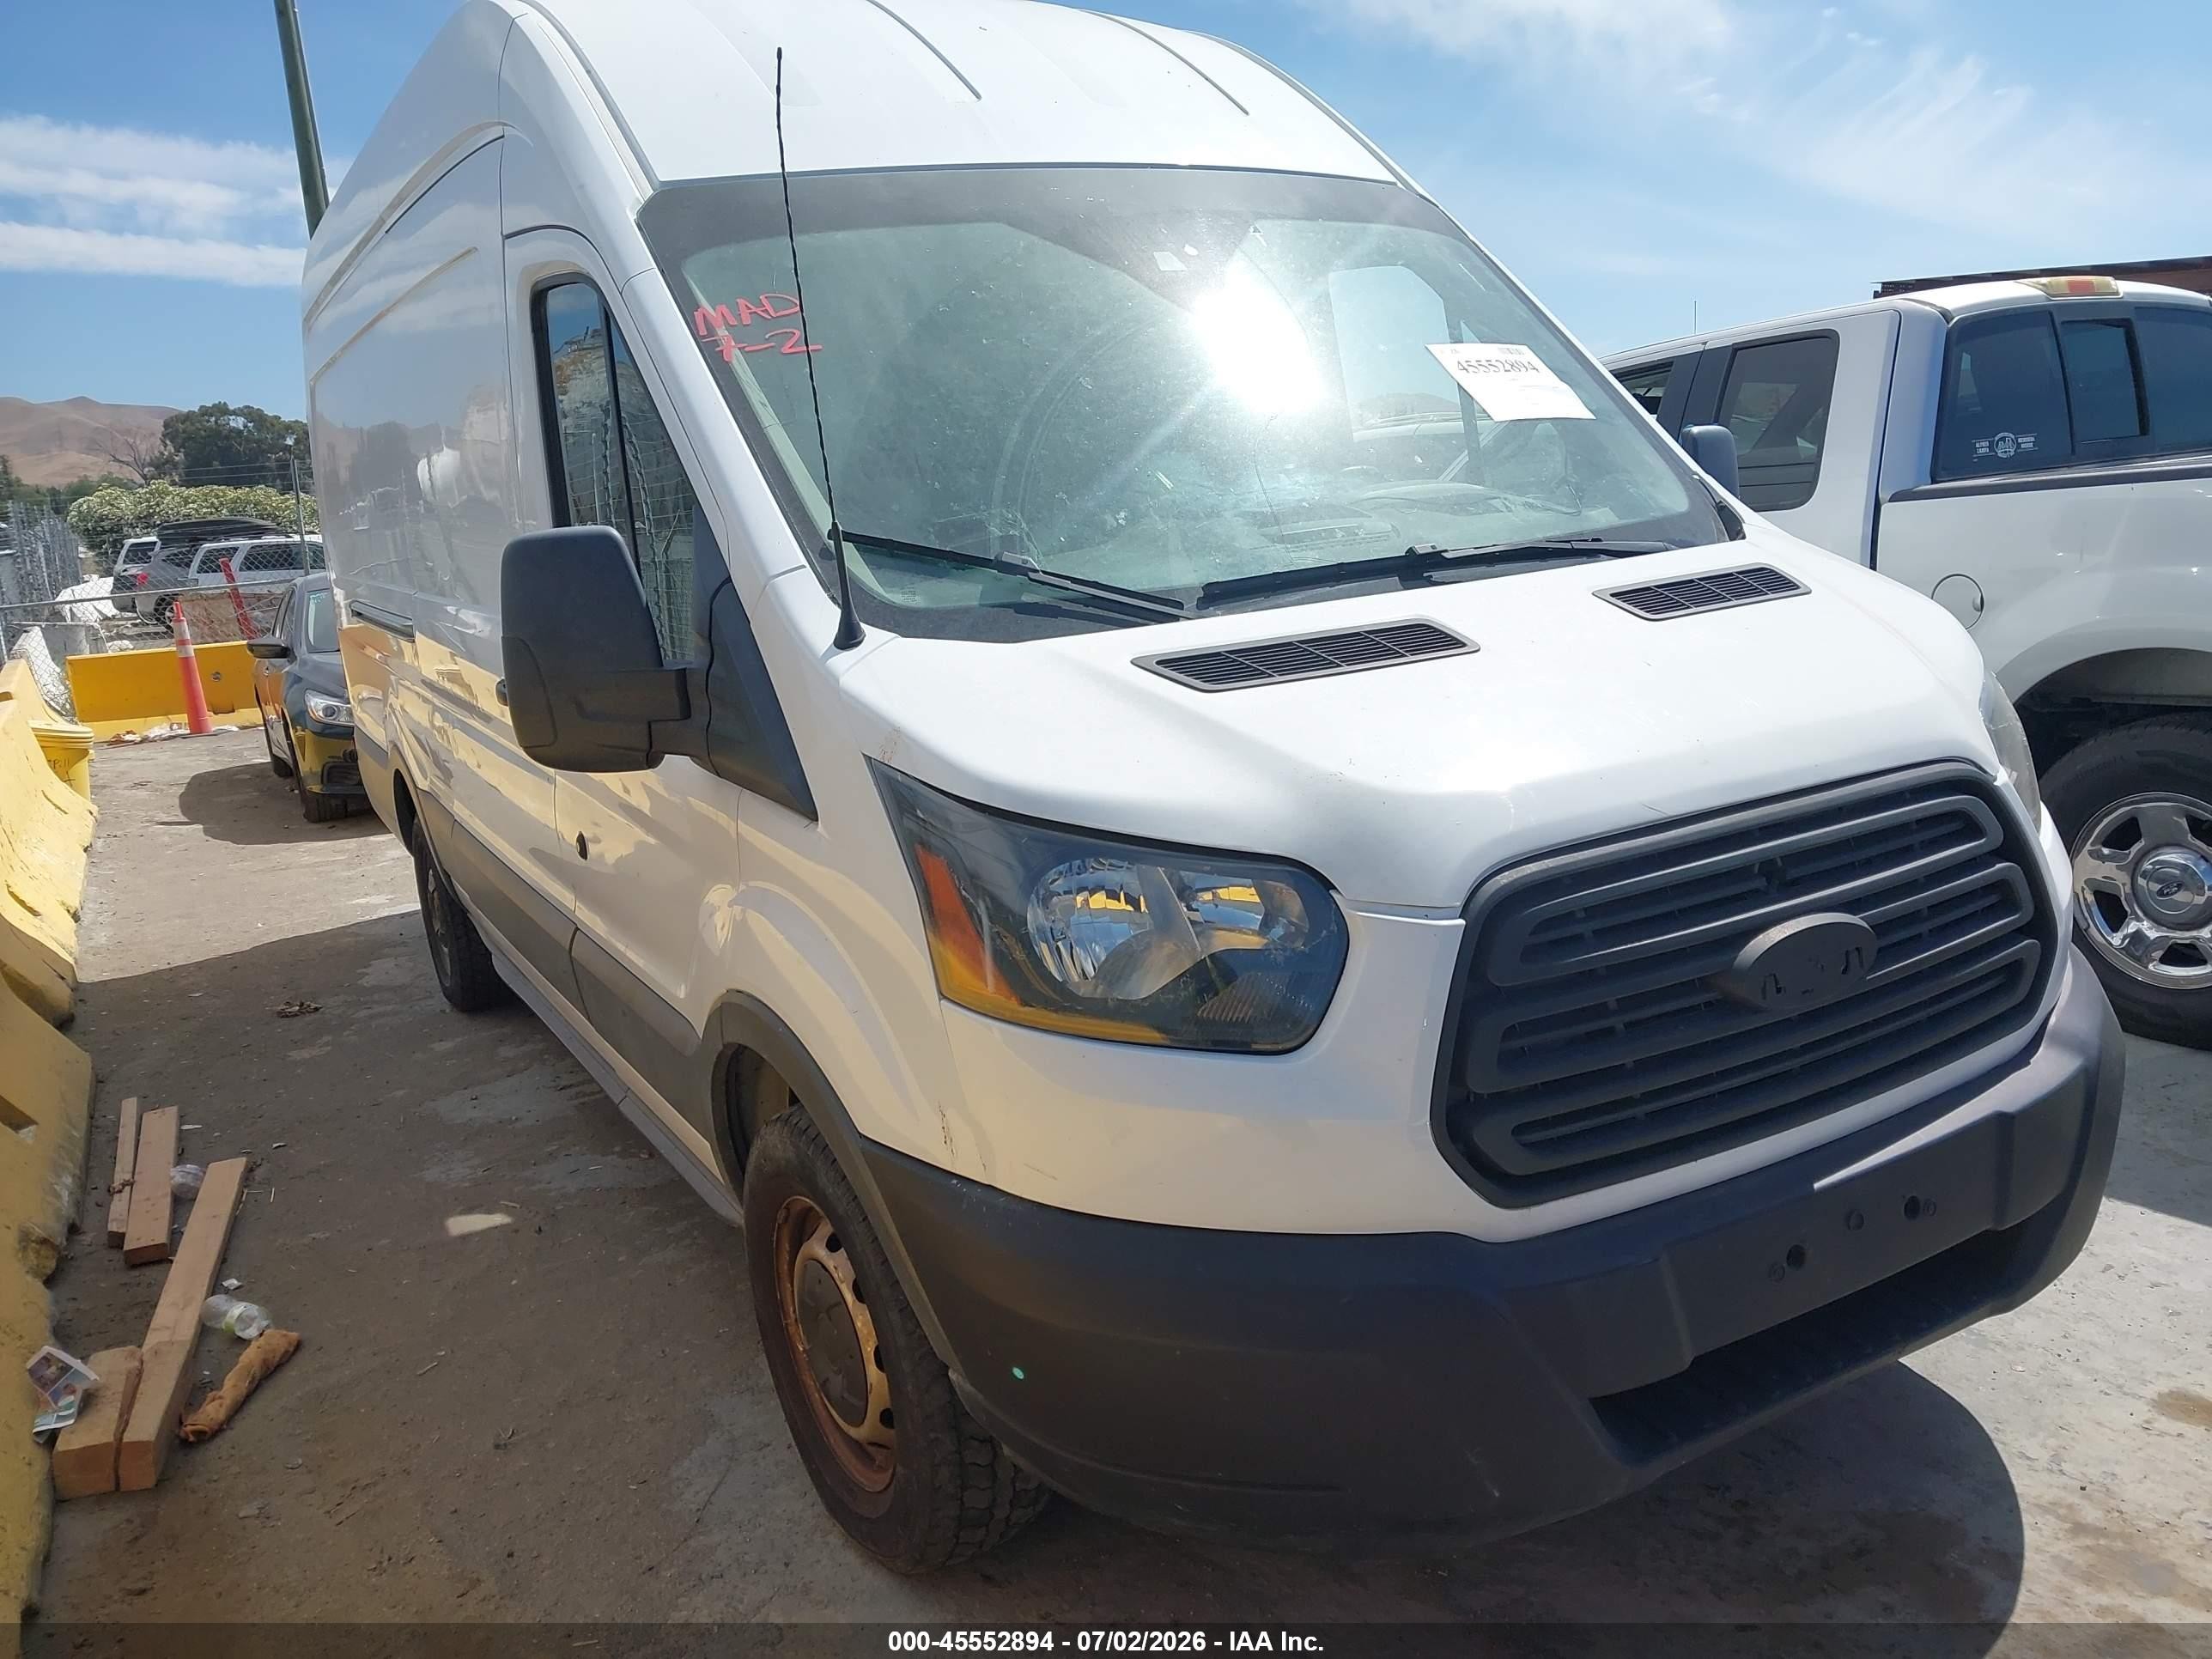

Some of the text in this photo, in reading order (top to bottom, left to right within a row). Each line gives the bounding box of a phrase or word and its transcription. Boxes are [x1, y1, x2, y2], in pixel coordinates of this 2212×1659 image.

[693, 292, 800, 337] MAD
[700, 328, 823, 362] 7-2
[1456, 359, 1540, 374] 45552894
